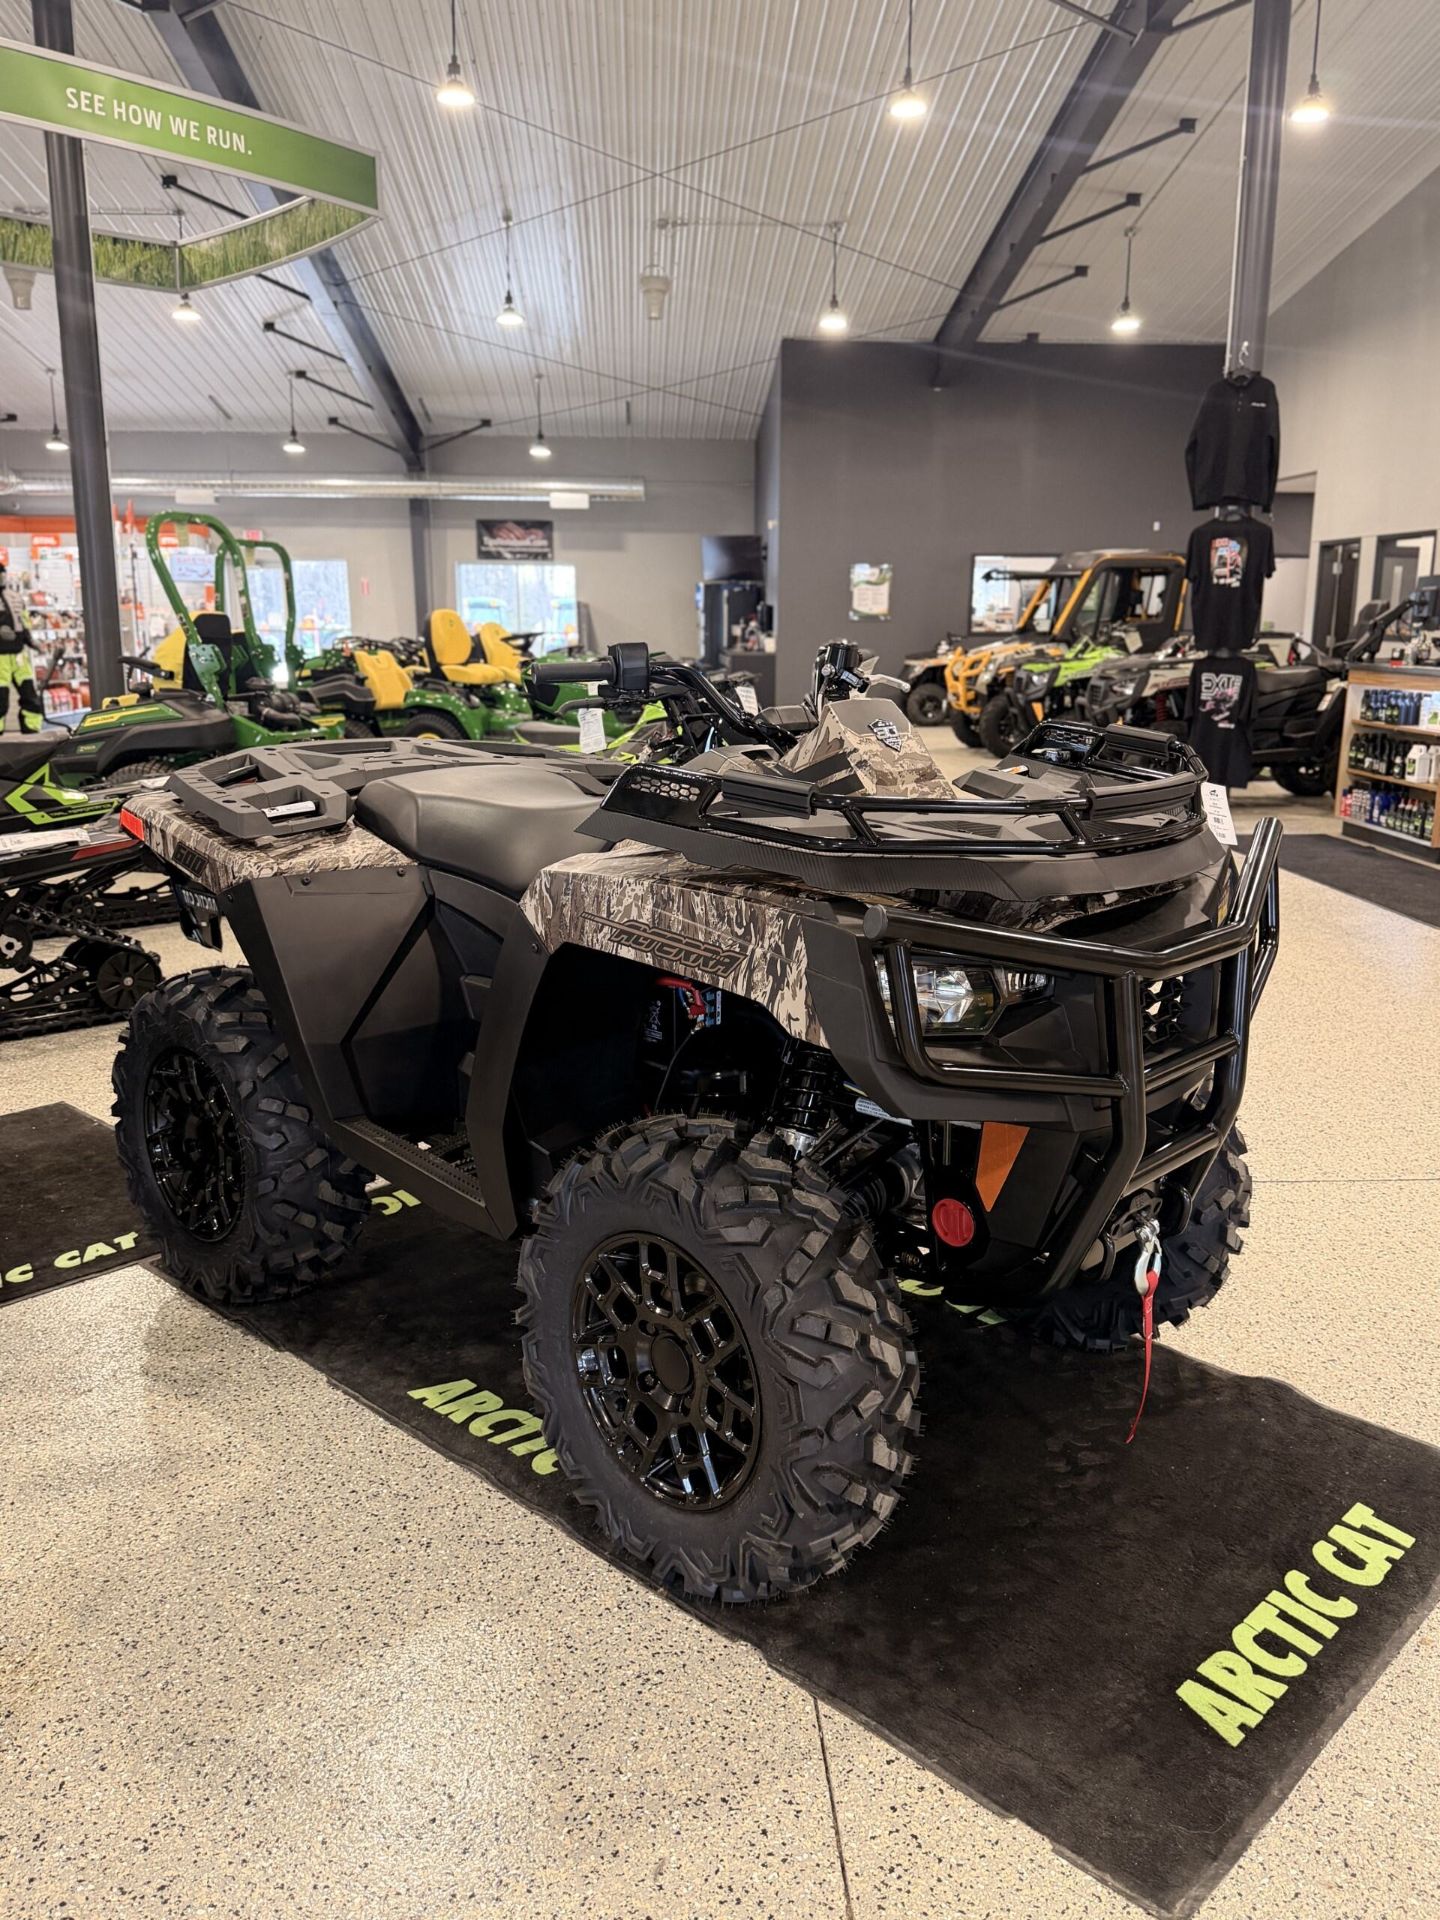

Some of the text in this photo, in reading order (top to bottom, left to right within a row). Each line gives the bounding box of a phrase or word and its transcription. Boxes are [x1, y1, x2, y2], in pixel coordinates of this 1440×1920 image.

[65, 87, 252, 155] SEE HOW WE RUN.
[608, 918, 748, 979] ALTERRA
[53, 1231, 139, 1269] CAT
[1175, 1501, 1417, 1748] ARCTIC CAT
